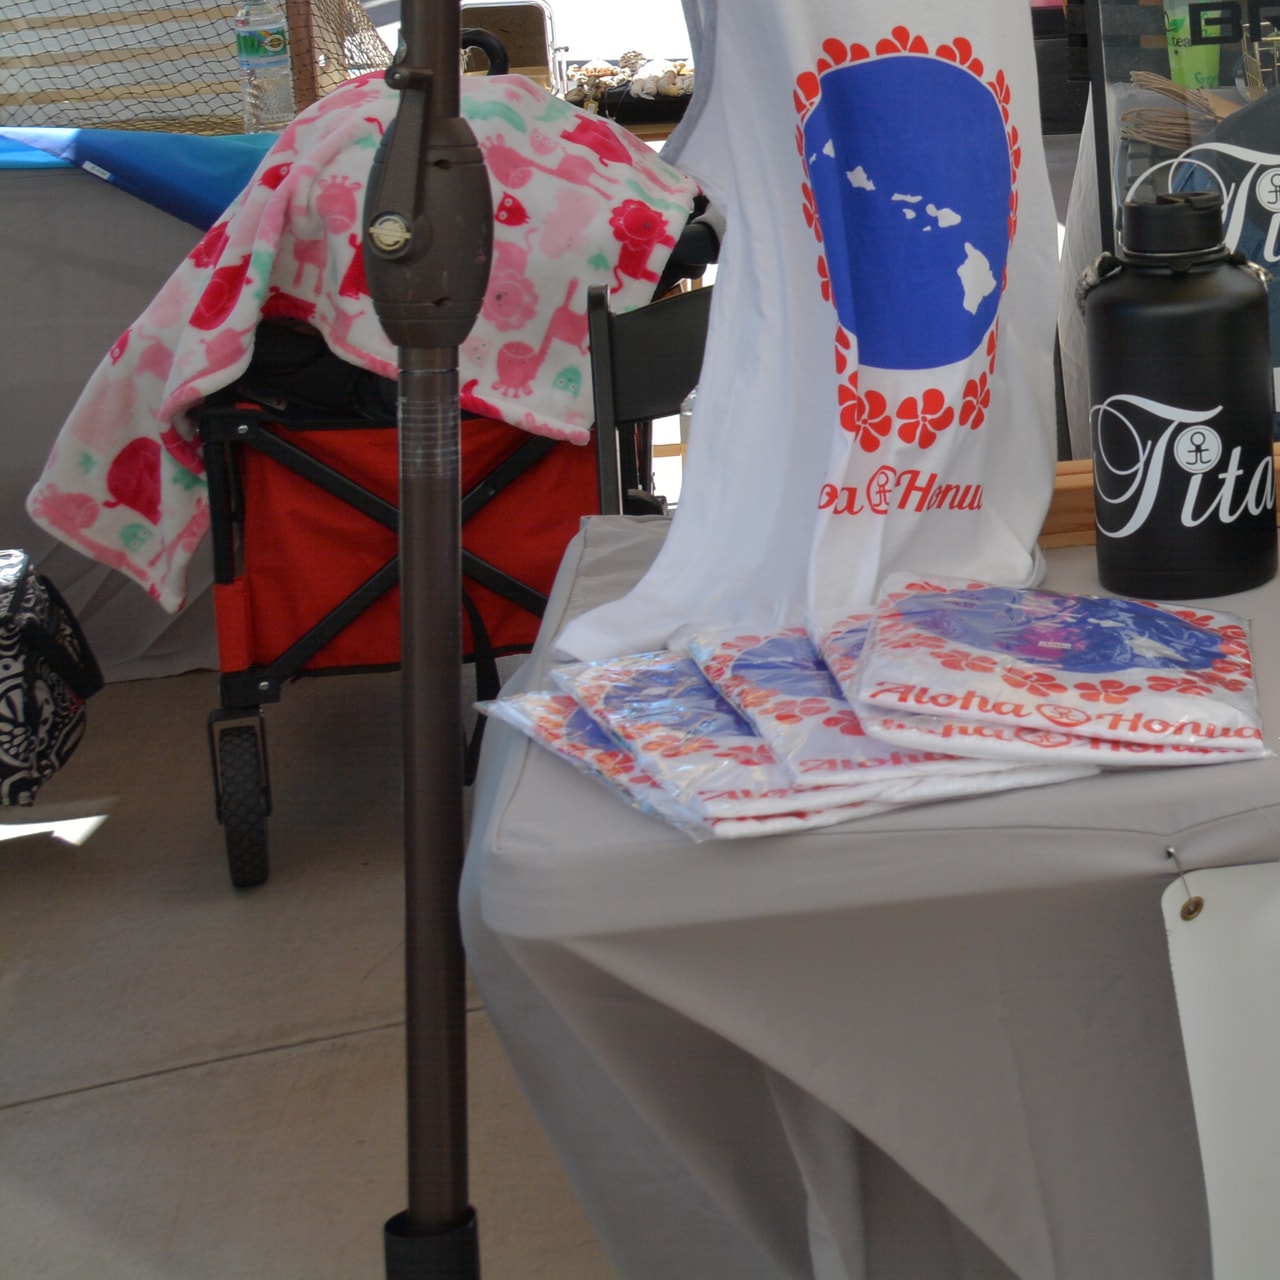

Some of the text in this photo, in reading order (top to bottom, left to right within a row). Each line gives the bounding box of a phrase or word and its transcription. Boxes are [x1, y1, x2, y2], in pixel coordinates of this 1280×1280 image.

[1089, 394, 1275, 538] Tita
[869, 680, 1262, 741] Aloha Honua
